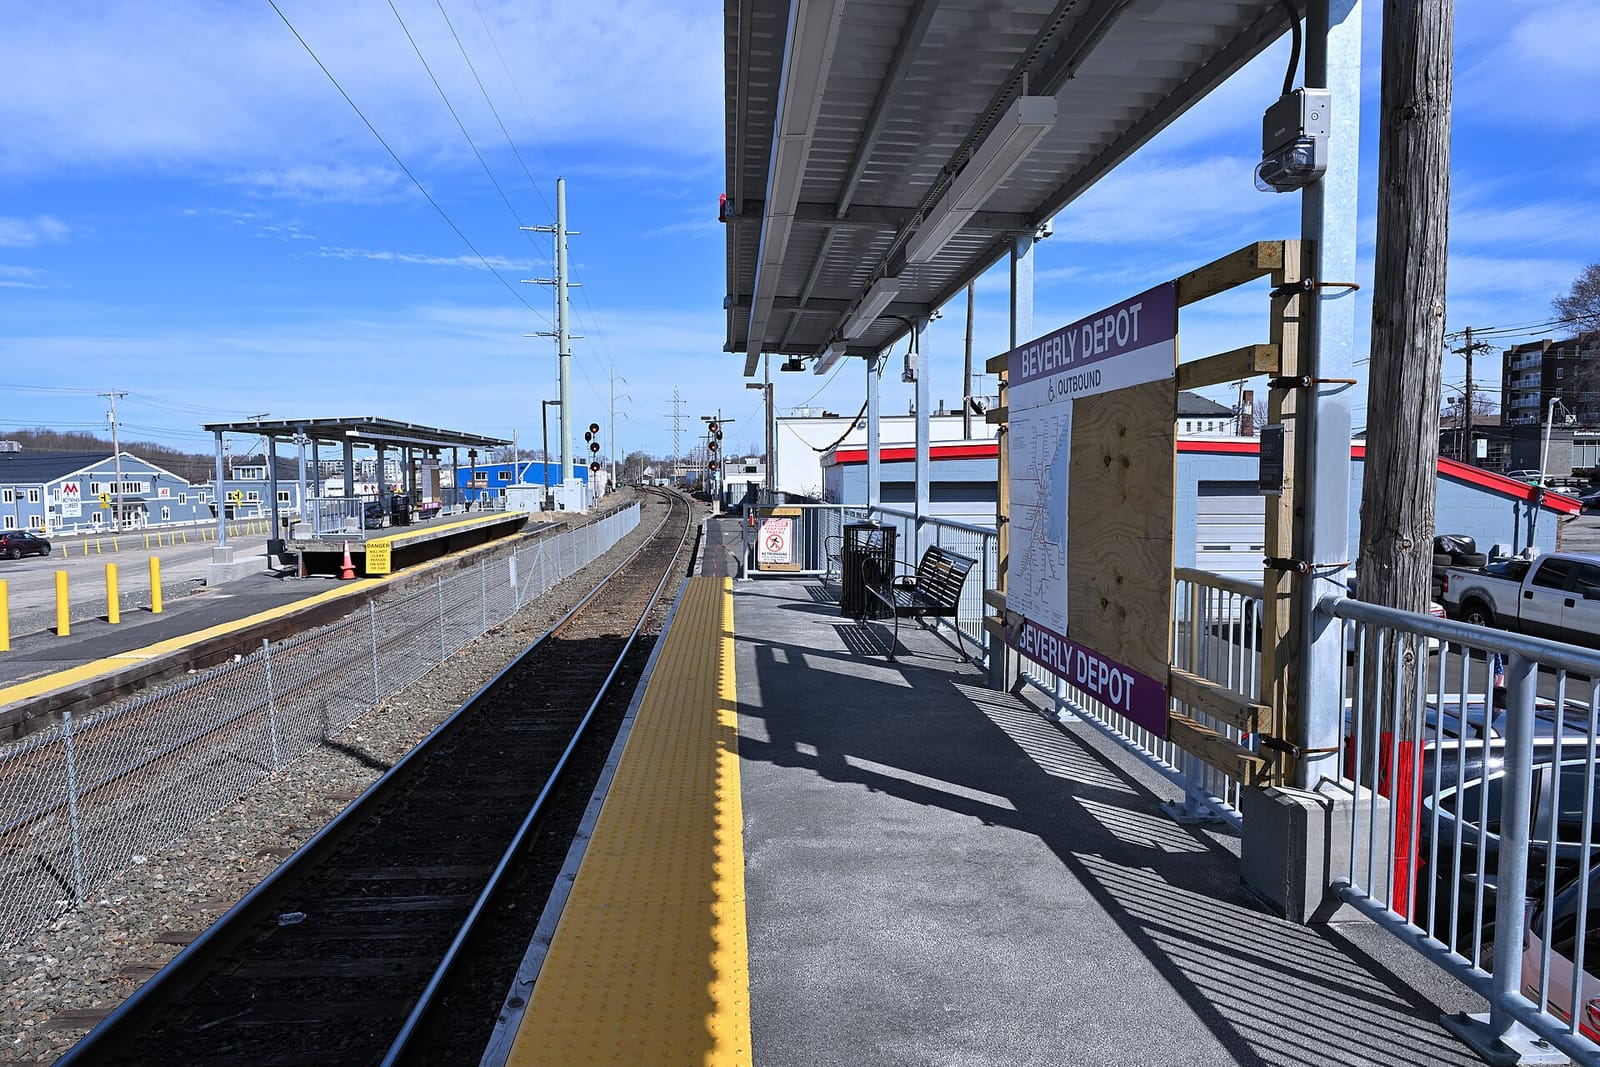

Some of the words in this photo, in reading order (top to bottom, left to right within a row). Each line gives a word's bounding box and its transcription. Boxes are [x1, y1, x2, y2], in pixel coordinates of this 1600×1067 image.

[1021, 329, 1078, 379] BEVERLY
[1082, 302, 1143, 359] DEPOT
[1057, 369, 1101, 396] OUTBOUND
[1019, 623, 1074, 675] BEVERLY
[1076, 650, 1135, 711] DEPOT
